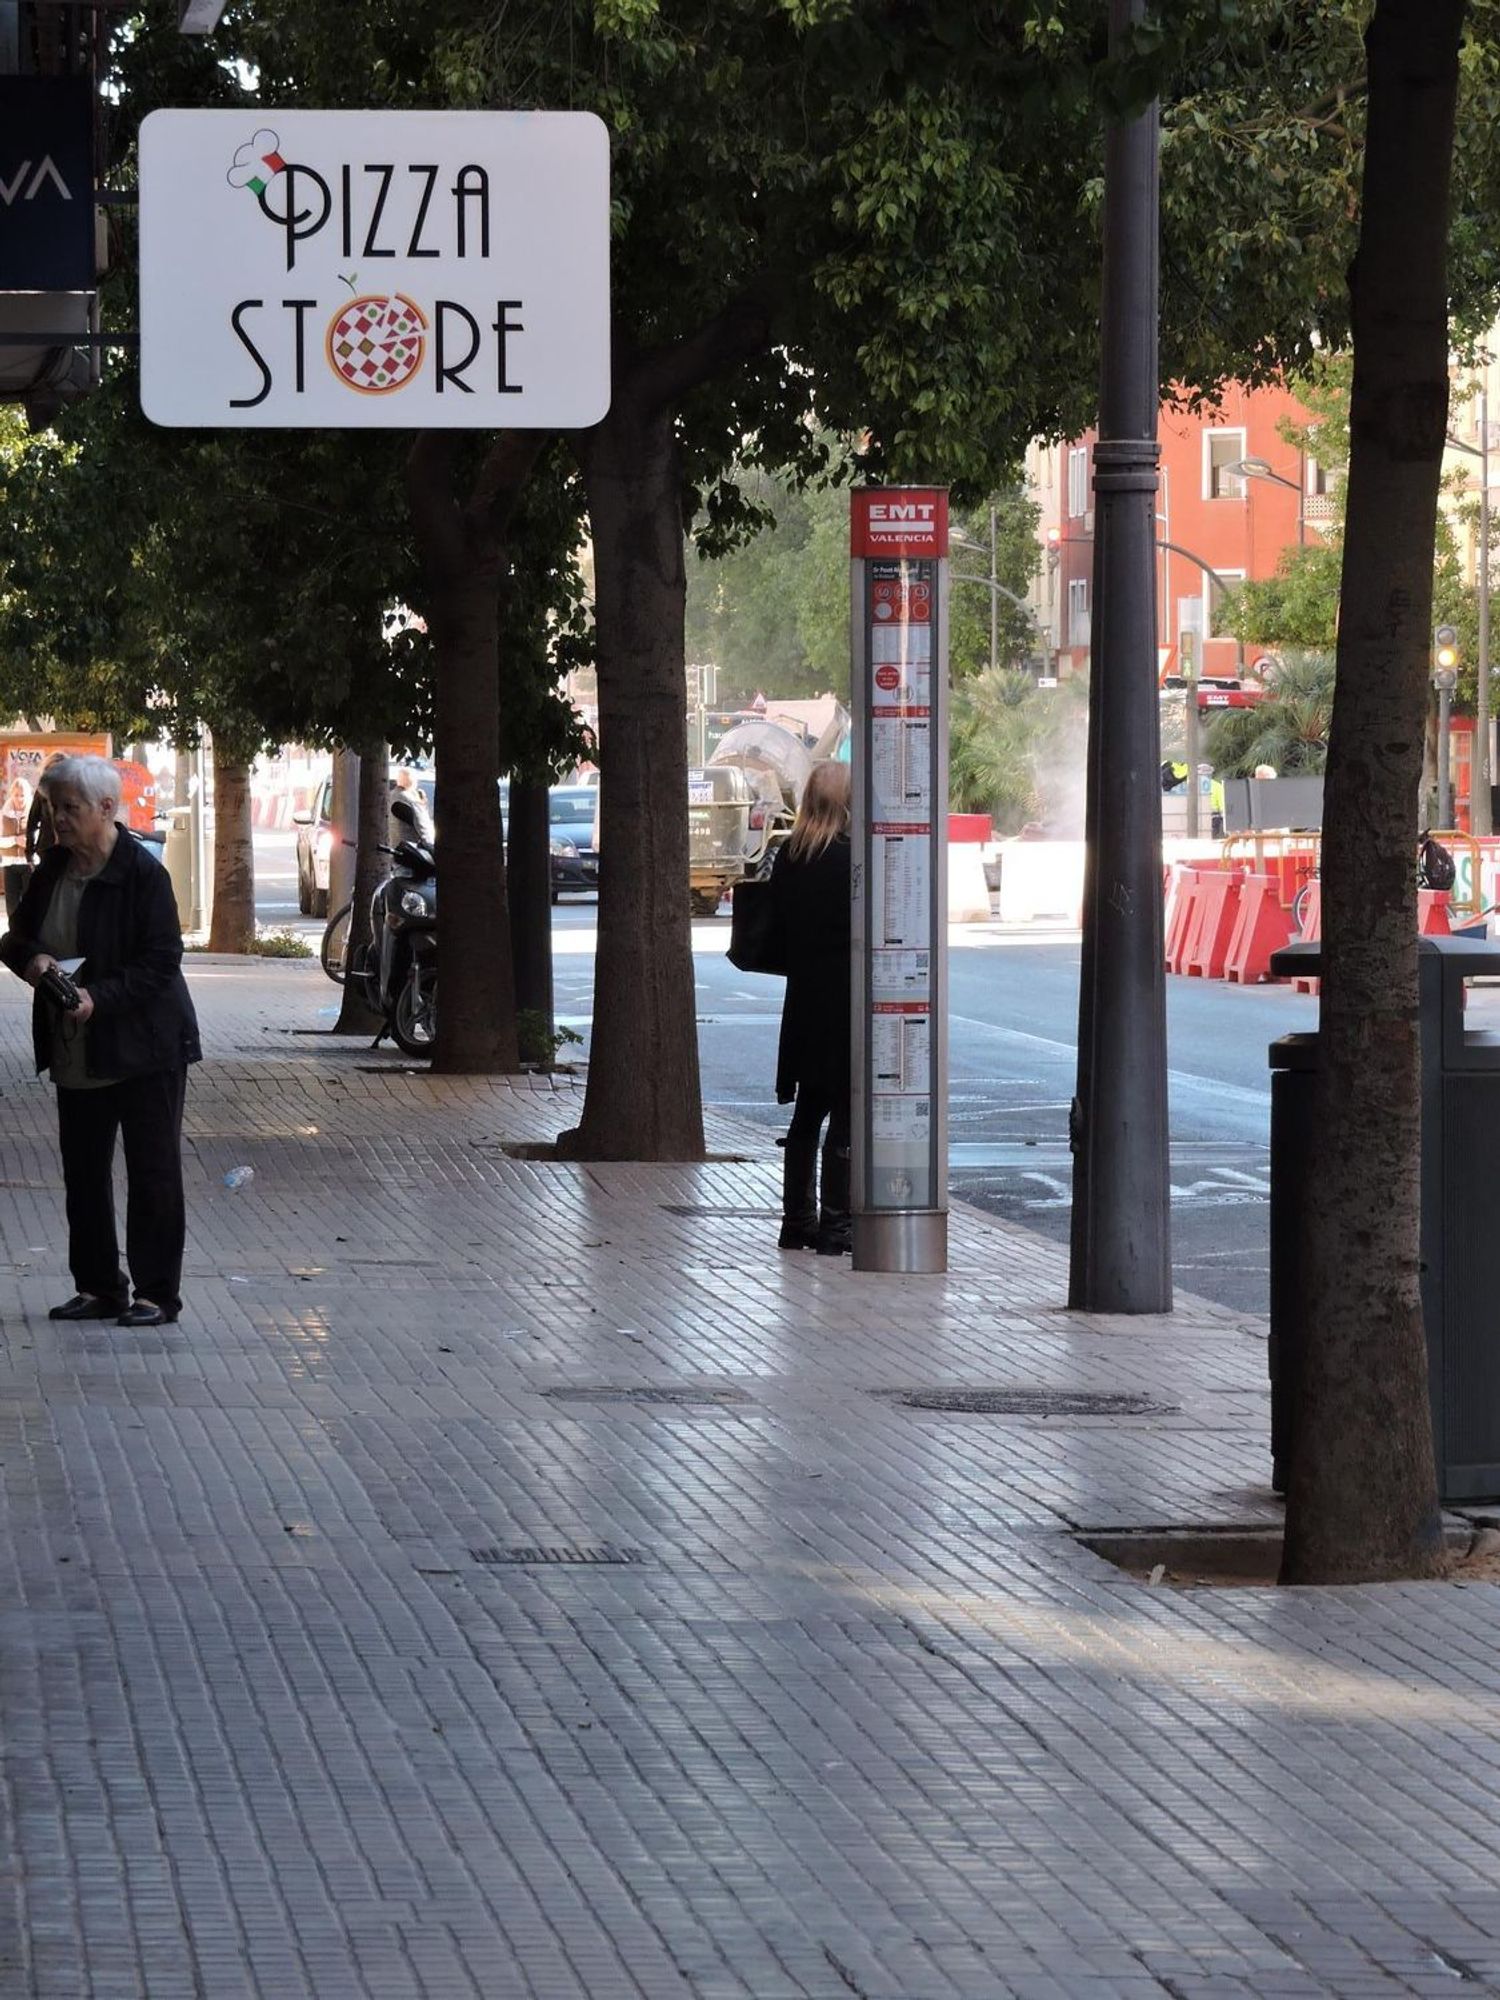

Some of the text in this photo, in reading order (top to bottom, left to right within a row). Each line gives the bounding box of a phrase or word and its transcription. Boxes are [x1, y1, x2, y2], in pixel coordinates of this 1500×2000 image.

[257, 163, 490, 271] PIZZA
[229, 291, 524, 408] STORE
[869, 504, 934, 519] EMT
[869, 534, 934, 542] VALENCIA
